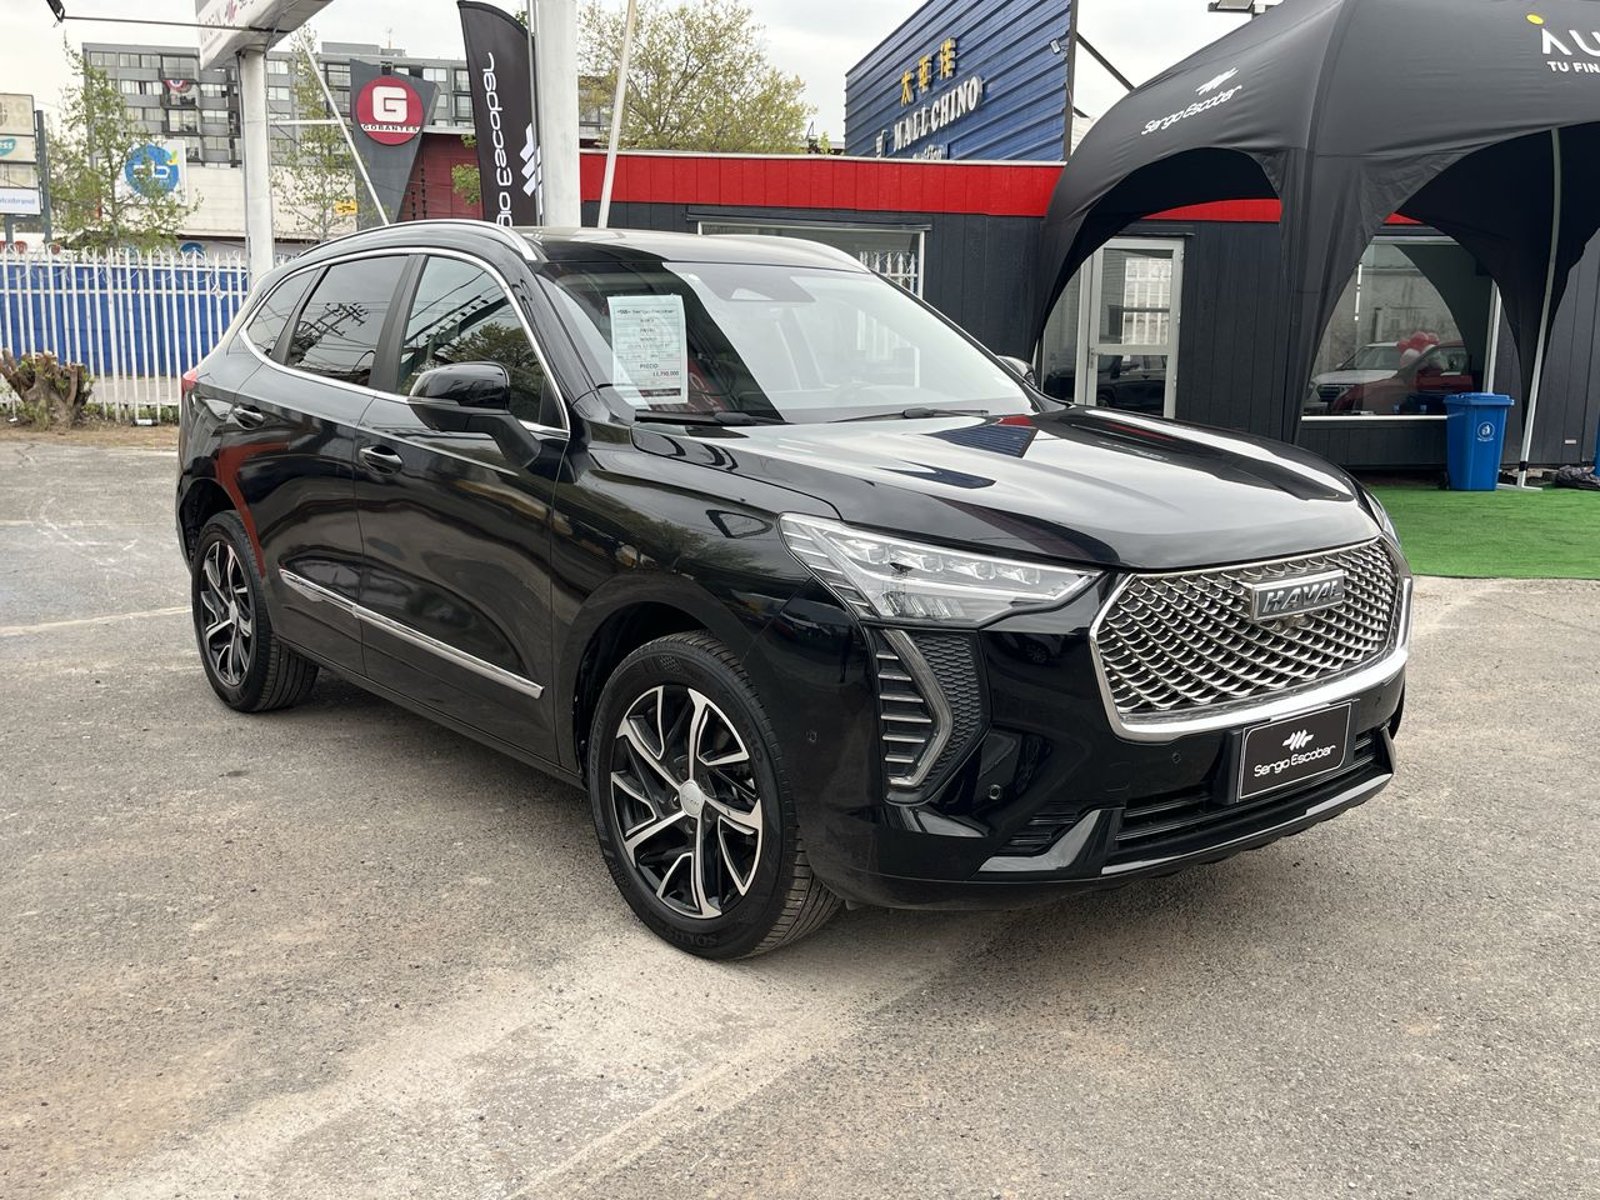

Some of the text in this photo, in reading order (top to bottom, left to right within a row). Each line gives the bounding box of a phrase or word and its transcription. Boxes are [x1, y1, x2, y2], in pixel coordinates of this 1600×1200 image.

[1546, 61, 1570, 73] TU
[372, 86, 408, 123] G
[893, 76, 982, 152] MALL CHINO
[363, 124, 418, 133] GOBANTES
[1262, 580, 1341, 613] HAVAL
[1291, 745, 1336, 766] Escobar
